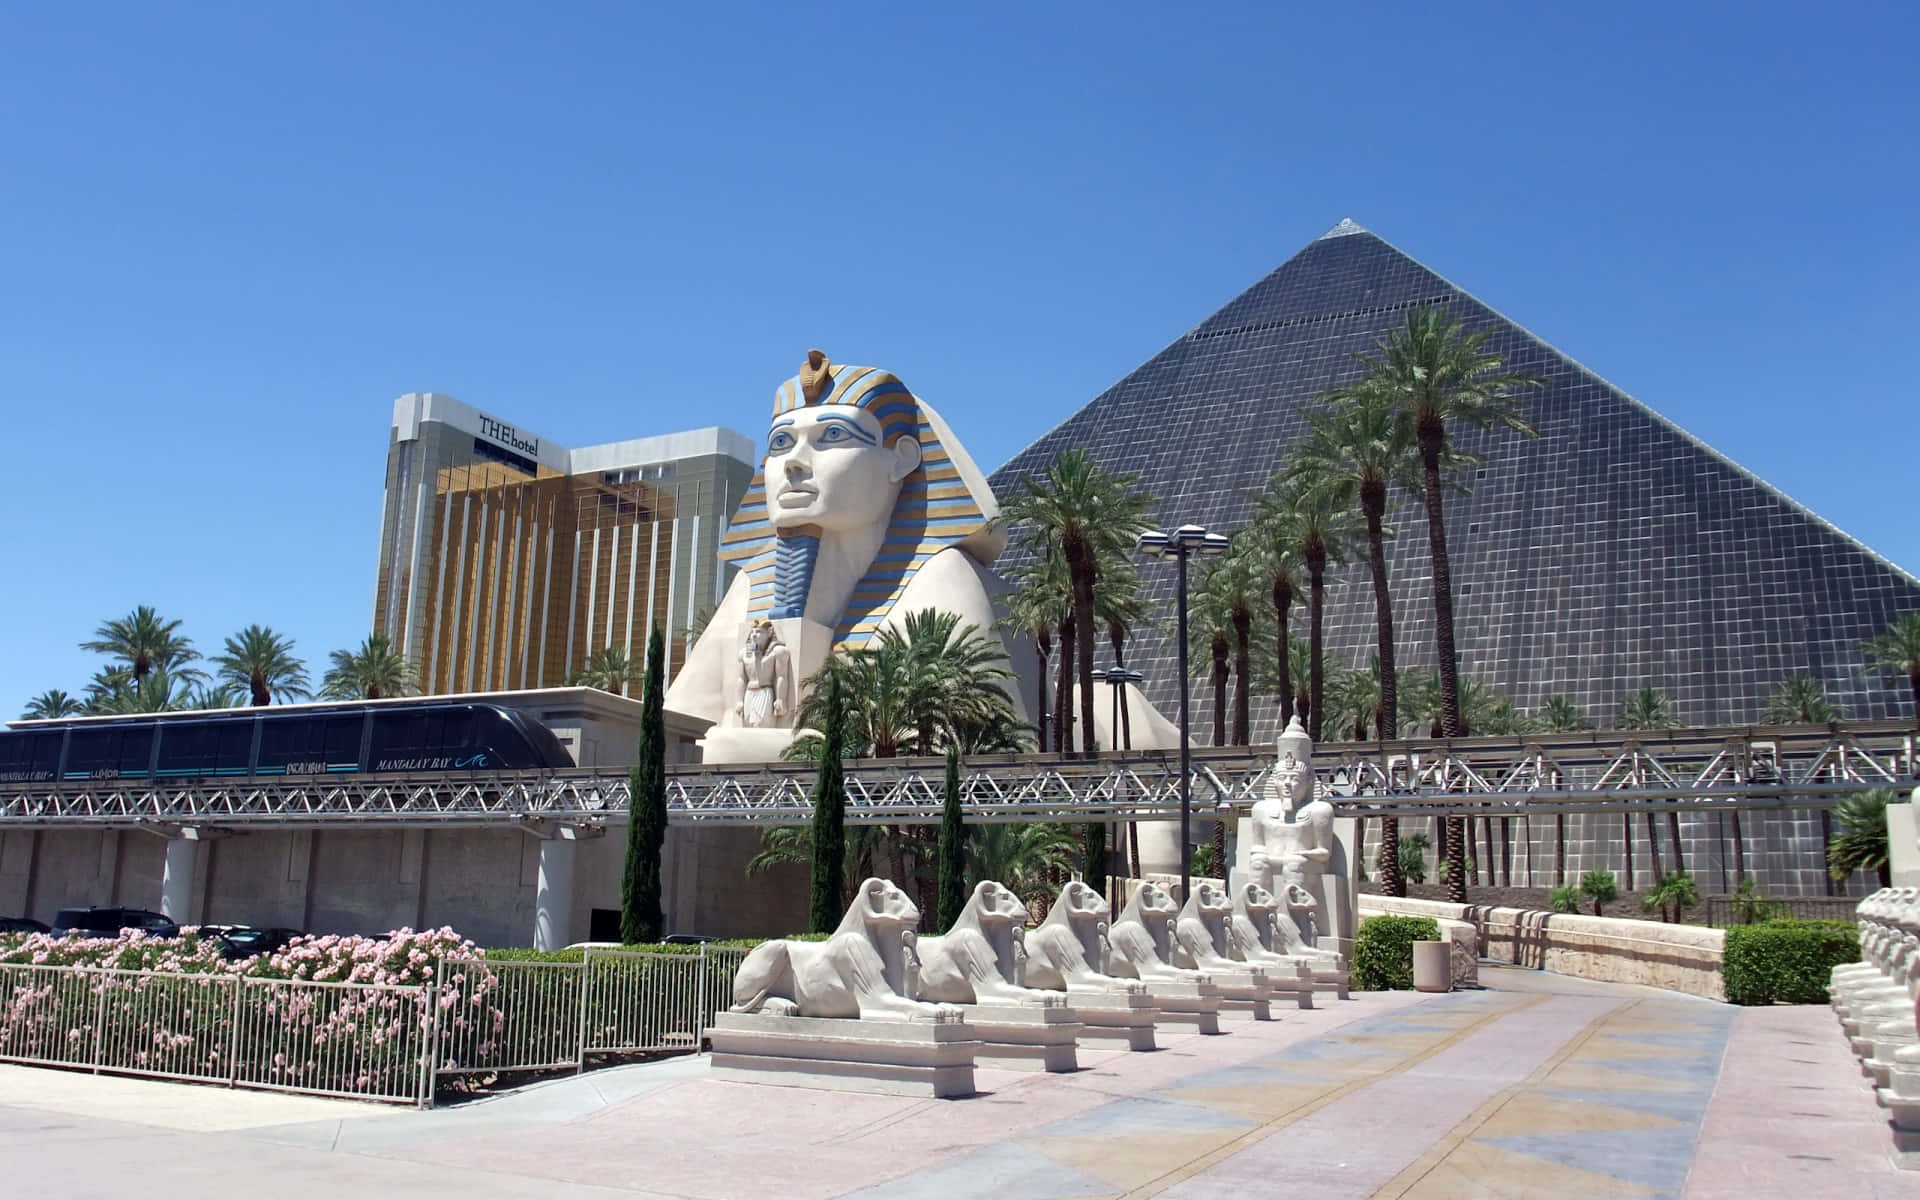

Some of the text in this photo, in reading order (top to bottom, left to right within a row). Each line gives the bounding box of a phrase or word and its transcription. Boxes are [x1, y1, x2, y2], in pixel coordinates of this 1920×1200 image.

[479, 413, 538, 457] THEhotel
[376, 757, 451, 770] MANDALAY BAY
